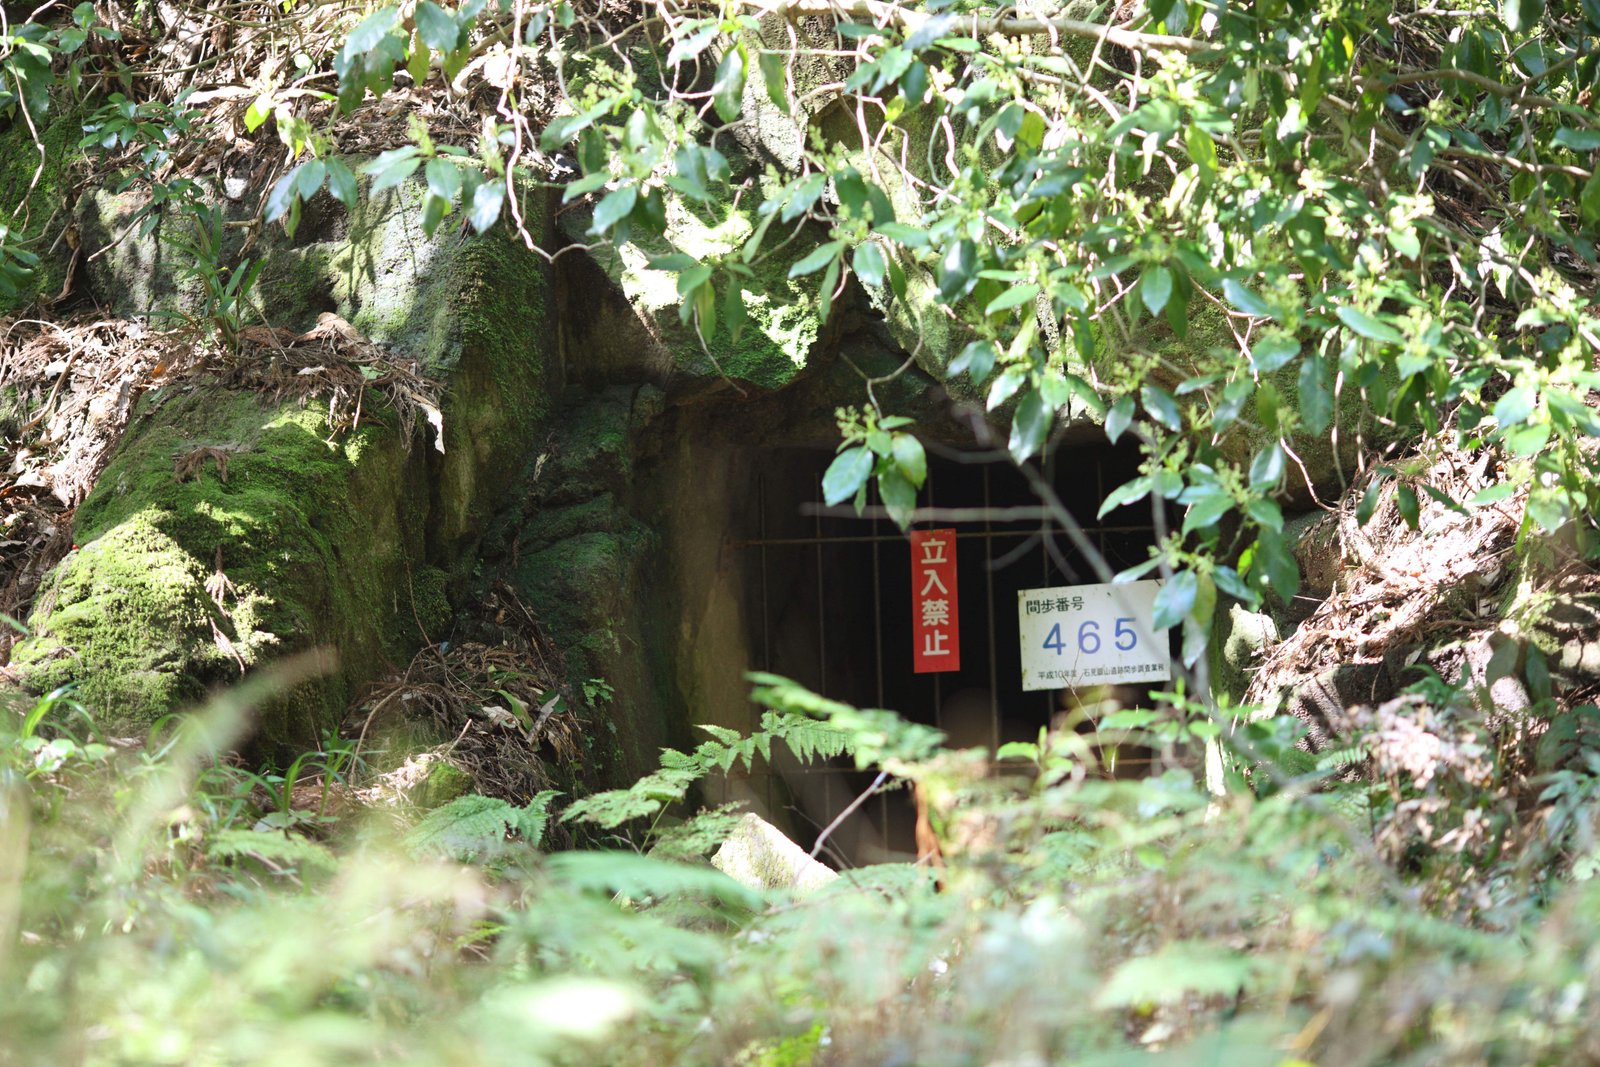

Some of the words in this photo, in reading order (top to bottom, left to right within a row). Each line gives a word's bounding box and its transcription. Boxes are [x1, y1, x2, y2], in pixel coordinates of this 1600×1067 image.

[920, 538, 950, 656] 立入禁止
[1026, 596, 1084, 615] 間歩番号
[1042, 617, 1137, 655] 465
